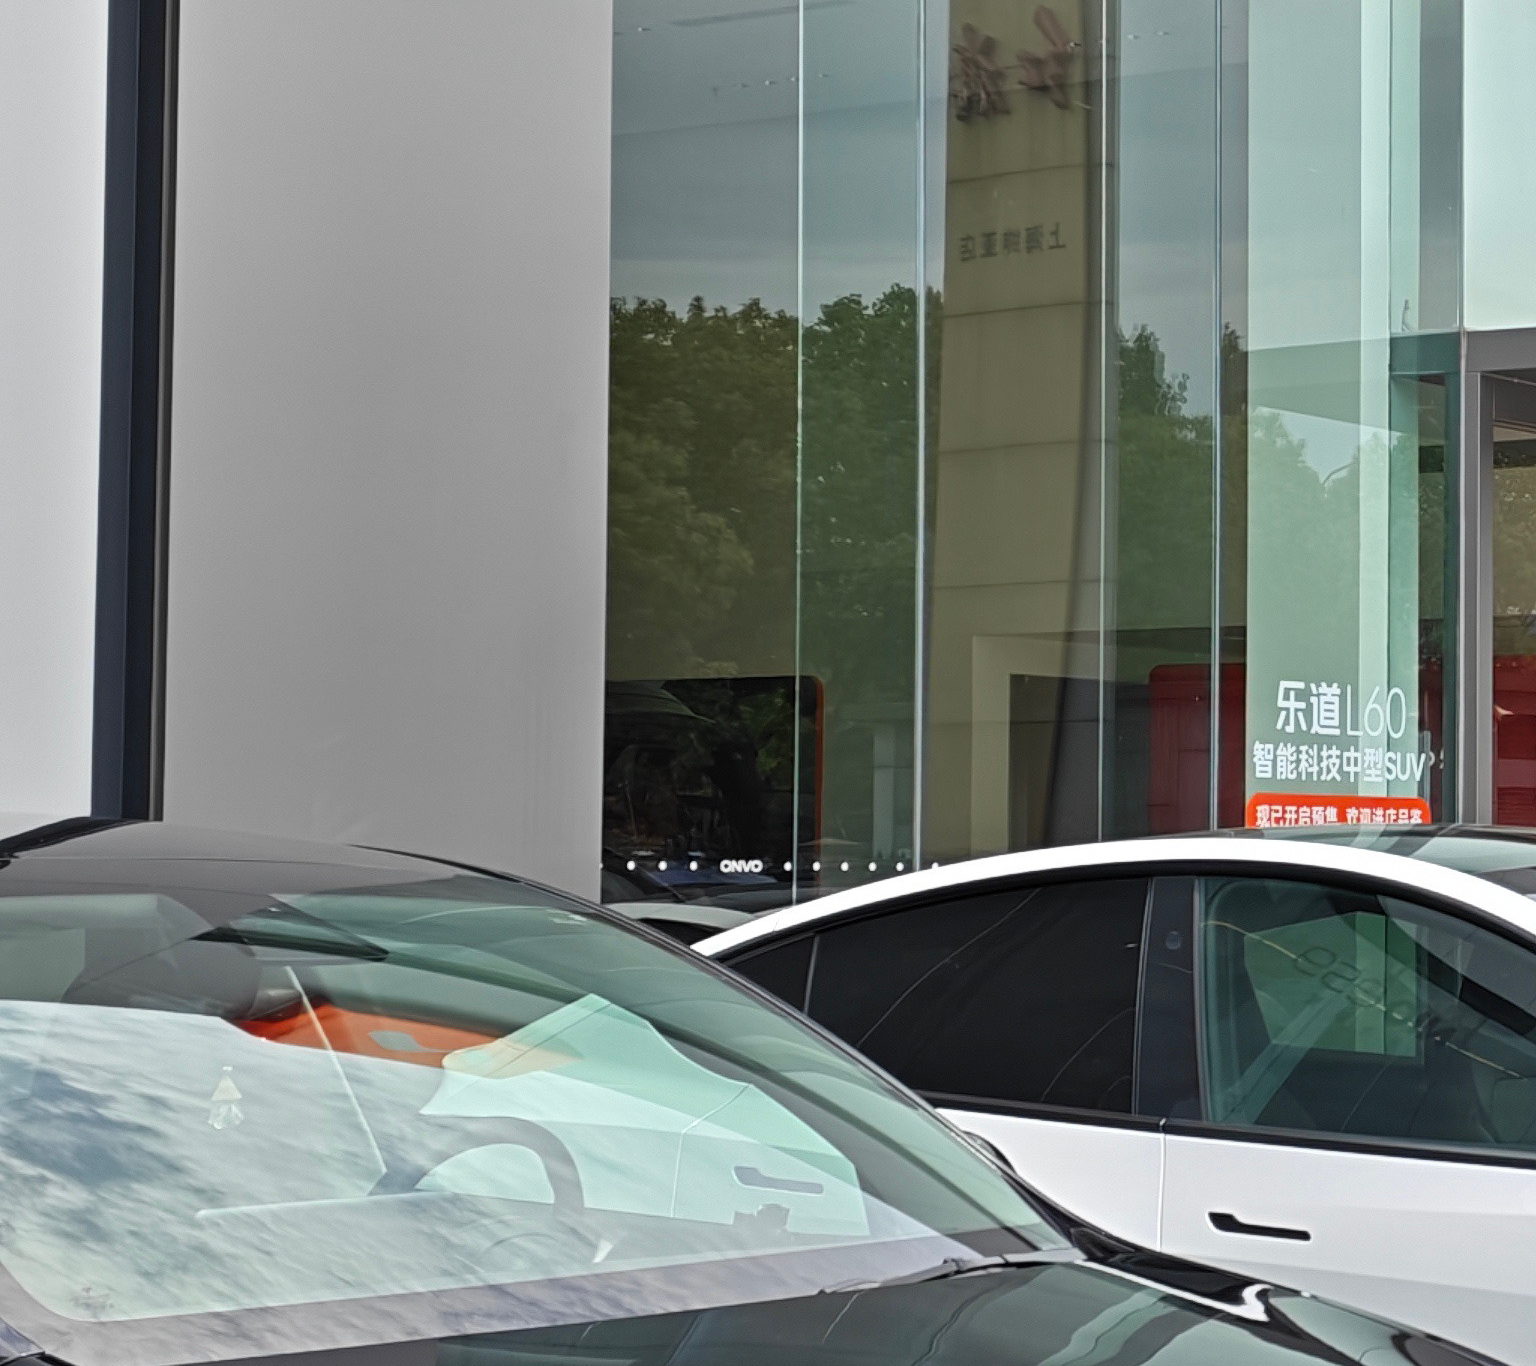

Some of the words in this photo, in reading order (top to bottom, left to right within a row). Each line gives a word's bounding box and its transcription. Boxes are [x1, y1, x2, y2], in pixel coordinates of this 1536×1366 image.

[1275, 679, 1407, 740] 乐道L60
[1252, 740, 1427, 783] 智能科技中型SUV
[719, 859, 764, 874] ONVO
